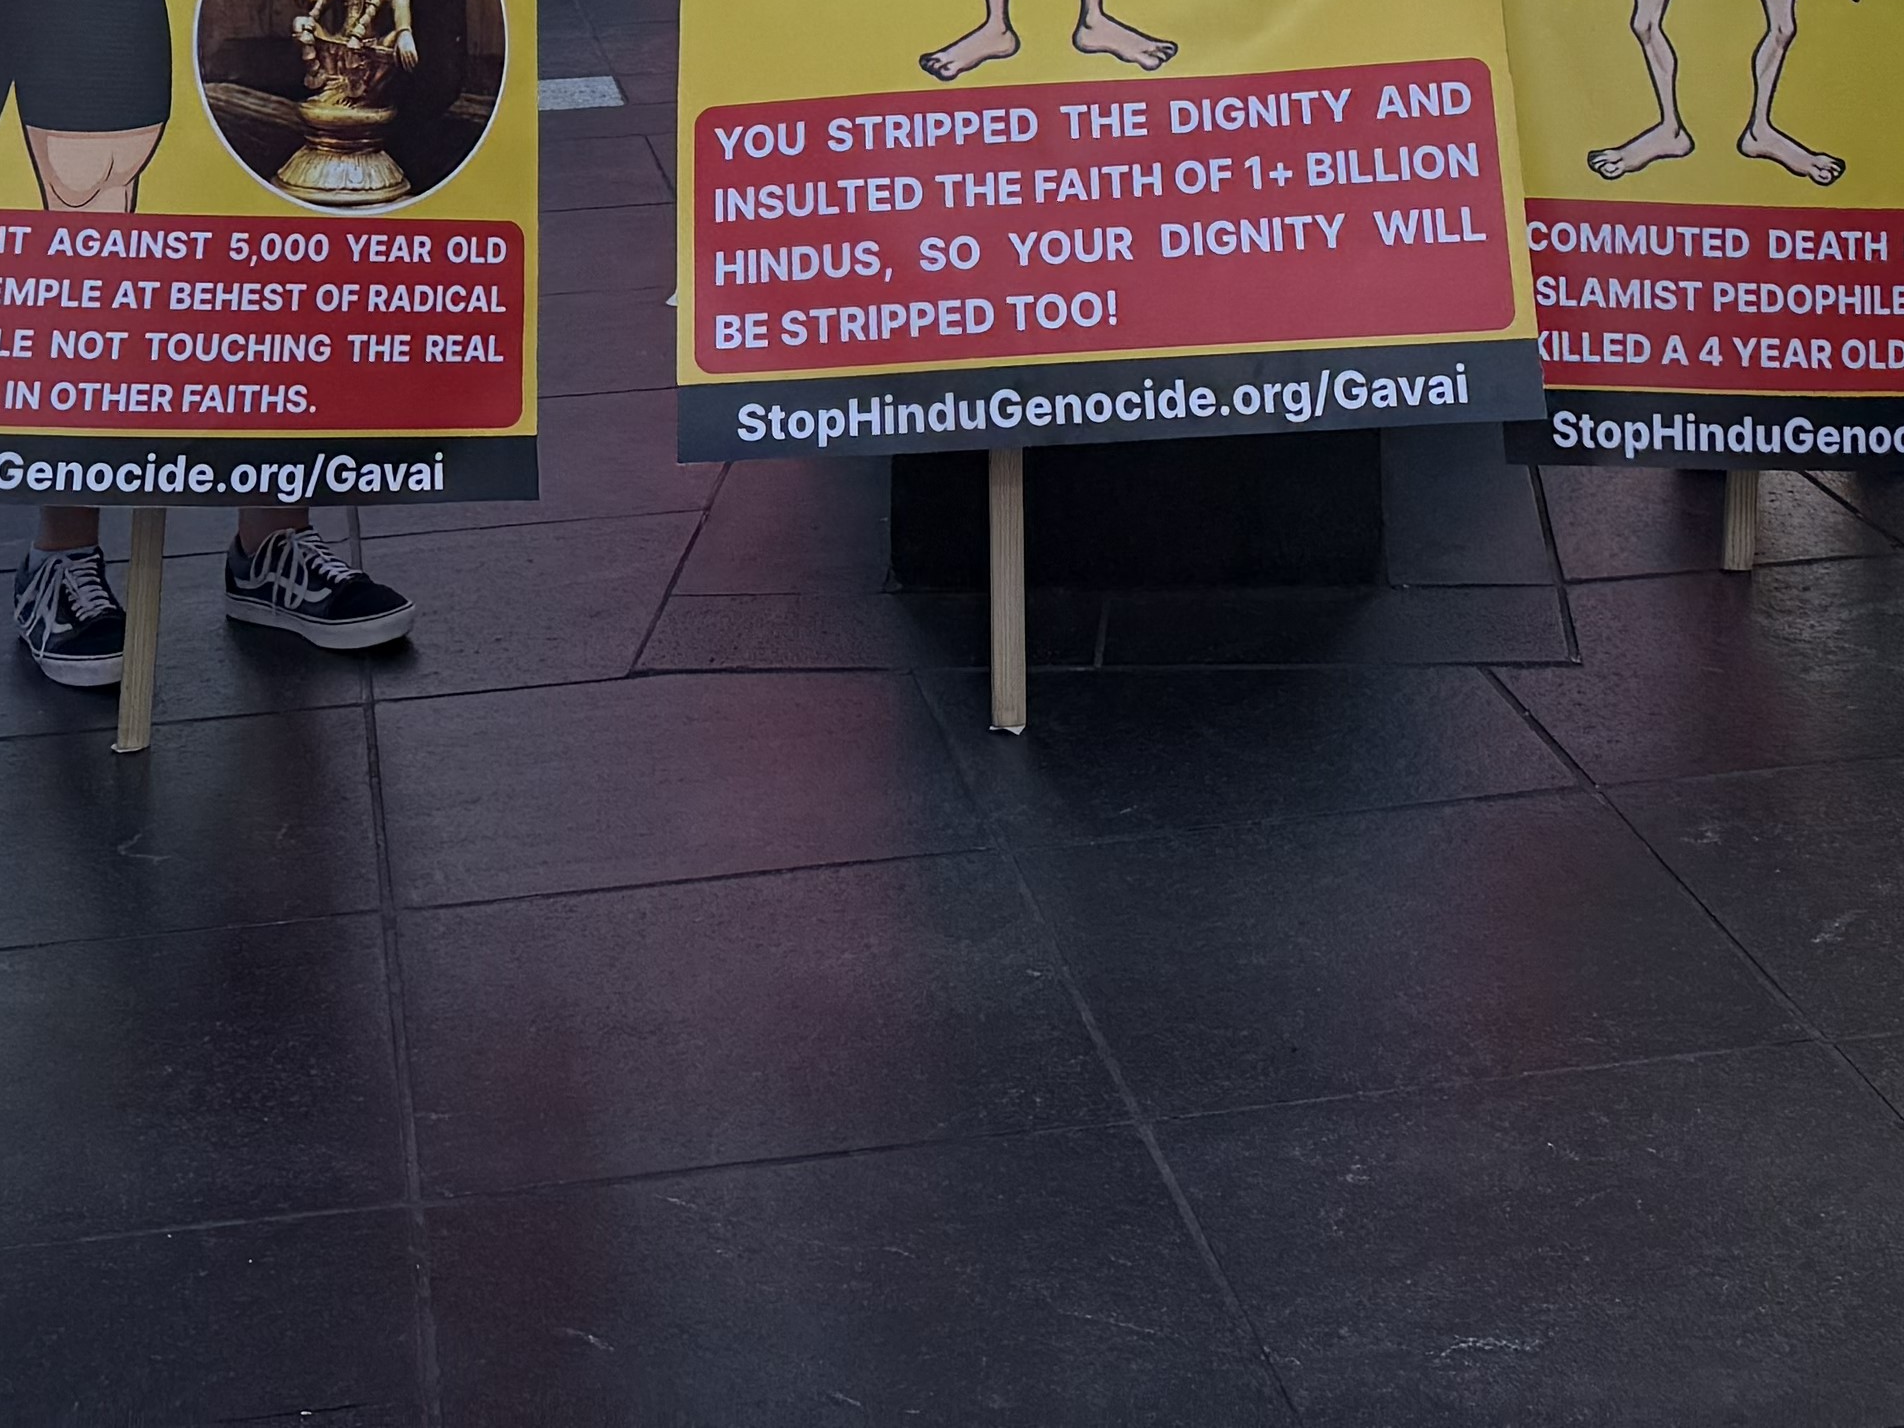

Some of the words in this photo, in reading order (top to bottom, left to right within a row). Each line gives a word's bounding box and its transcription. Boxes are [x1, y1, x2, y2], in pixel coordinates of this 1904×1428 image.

[714, 123, 806, 159] YOU
[827, 108, 1037, 152] STRIPPED
[1060, 101, 1147, 139] THE
[1169, 89, 1352, 133] DIGNITY
[1376, 82, 1472, 119] AND
[714, 177, 923, 222] INSULTED
[936, 170, 1021, 209] THE
[1033, 162, 1163, 203] FAITH
[1174, 157, 1235, 195] OF
[1244, 153, 1294, 190] 1+
[1306, 143, 1478, 186] BILLION
[714, 241, 893, 286] HINDUS,
[919, 235, 982, 271] SO
[1009, 226, 1134, 266] YOUR
[1161, 214, 1346, 260] DIGNITY
[1375, 207, 1486, 245] WILL
[715, 313, 769, 350] BE
[780, 296, 994, 345] STRIPPED
[1006, 291, 1117, 329] TOO!
[736, 364, 1470, 447] StopHinduGenocide.org/Gavai
